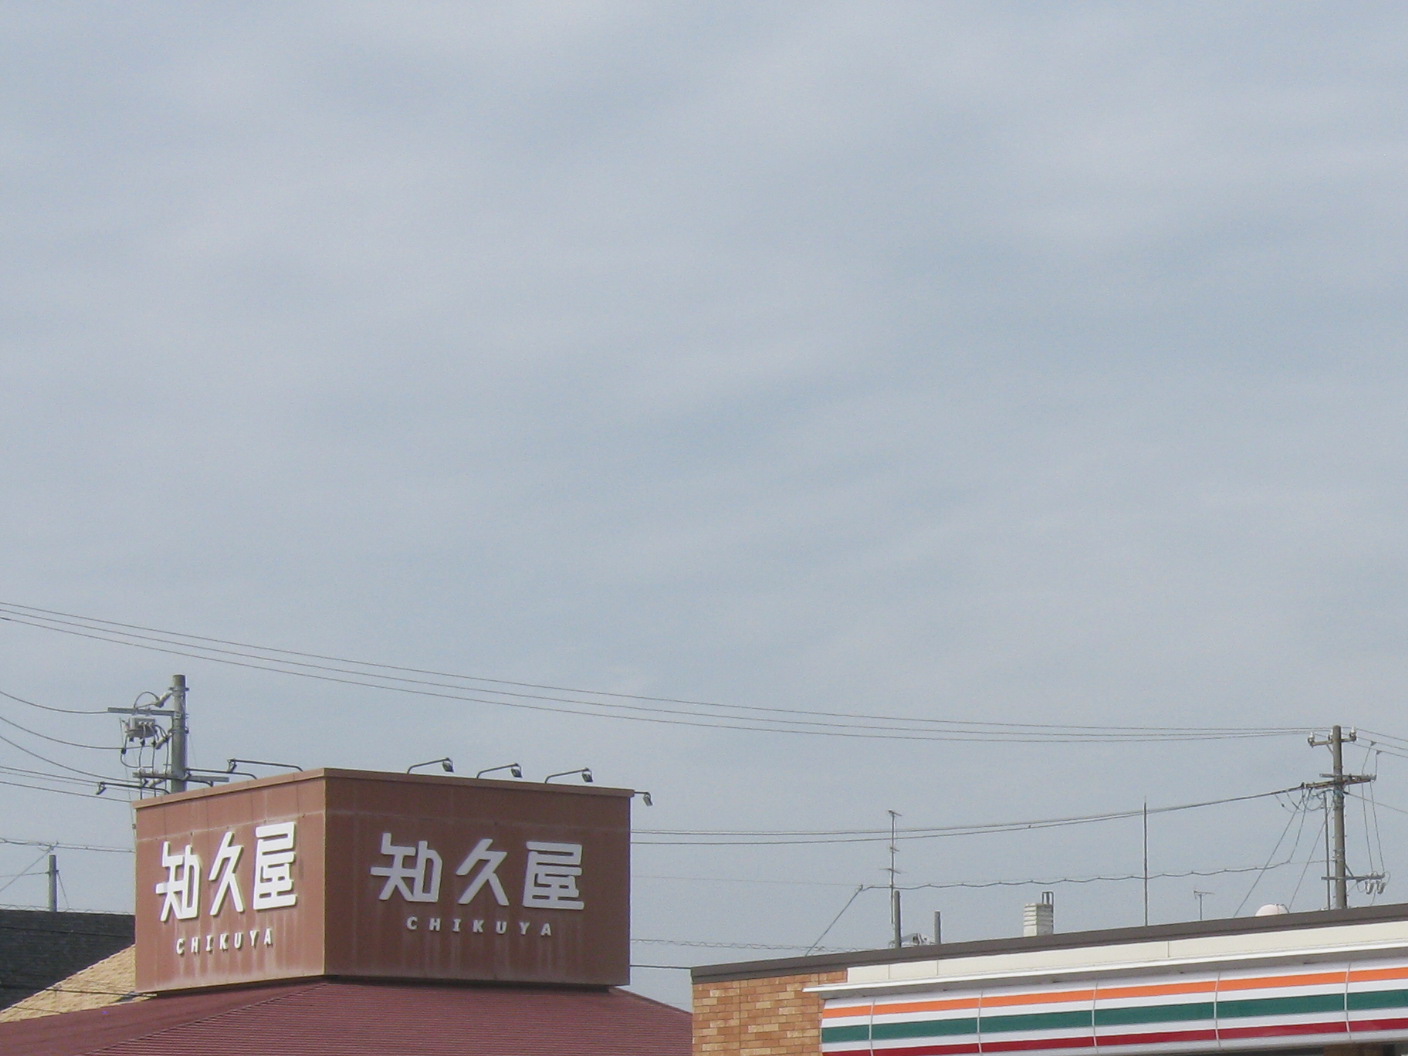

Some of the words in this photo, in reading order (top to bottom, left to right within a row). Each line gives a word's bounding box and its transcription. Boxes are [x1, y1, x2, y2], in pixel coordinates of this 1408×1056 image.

[155, 821, 297, 922] 知久屋
[370, 832, 584, 910] 知久屋
[176, 928, 272, 955] CHIKUYA
[406, 916, 552, 936] CHIKUYA
